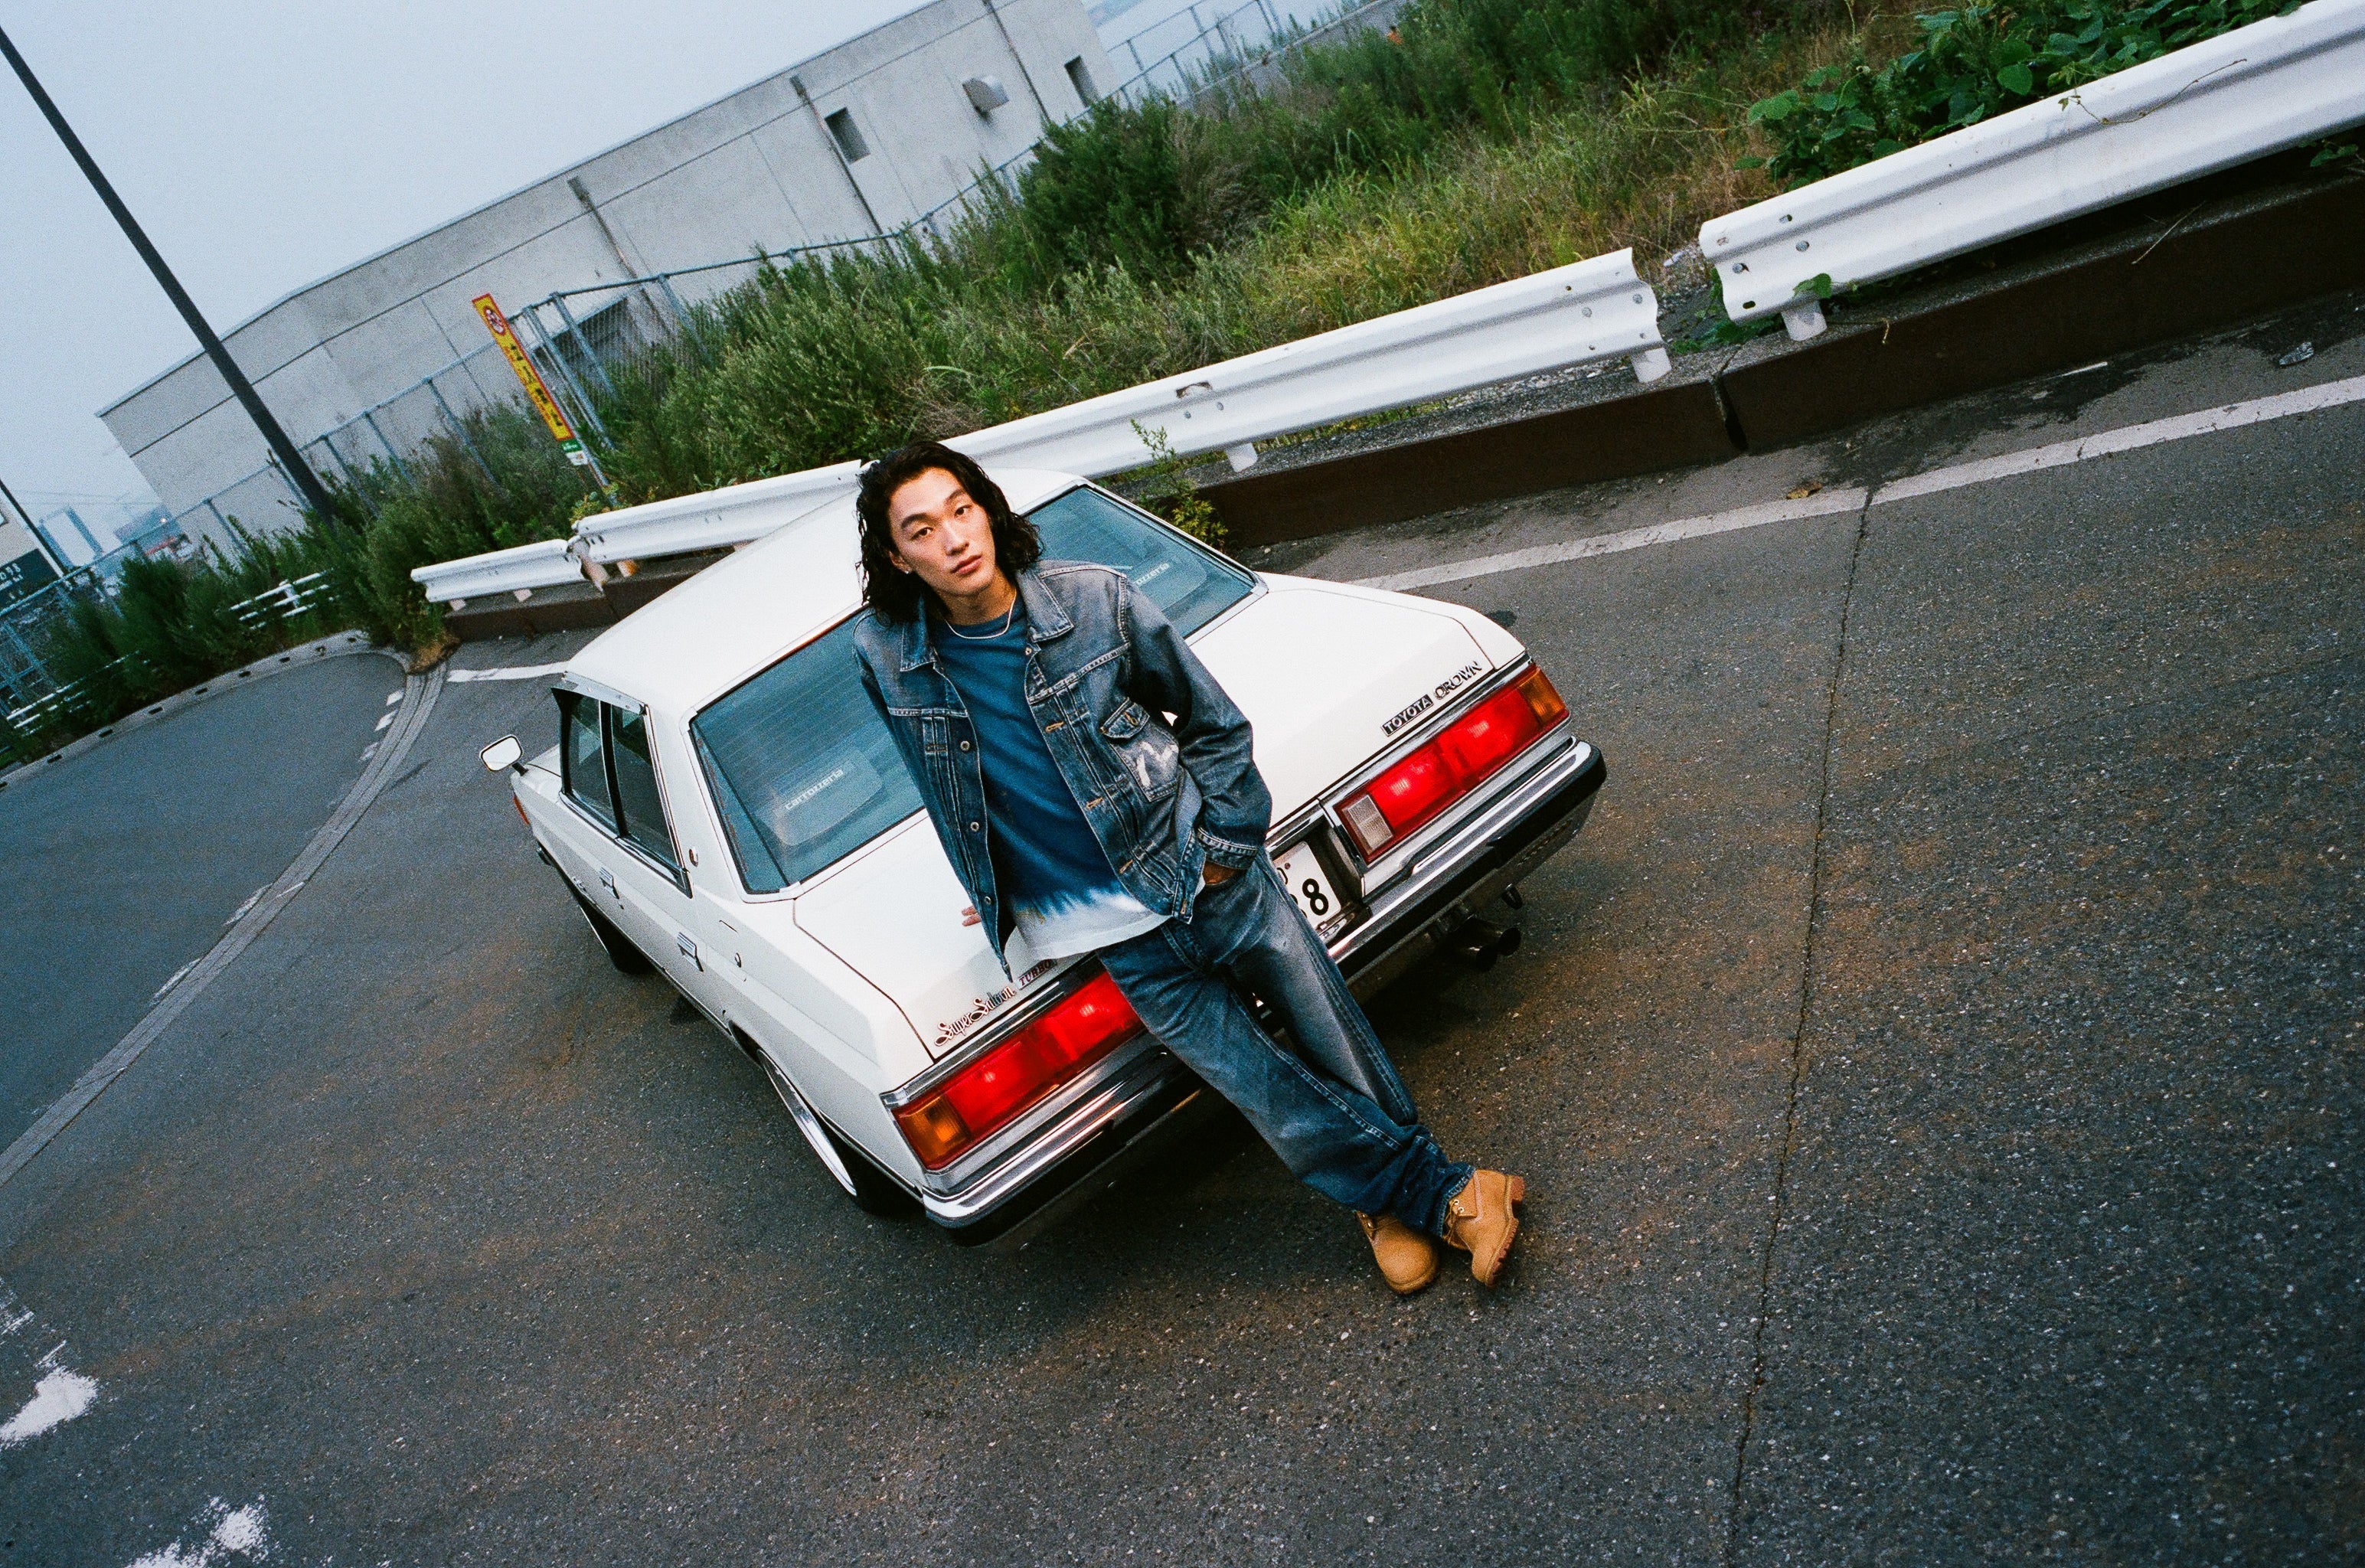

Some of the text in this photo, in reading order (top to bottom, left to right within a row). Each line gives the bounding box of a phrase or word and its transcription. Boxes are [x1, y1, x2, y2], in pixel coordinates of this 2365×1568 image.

[1134, 563, 1169, 586] ozzeria
[1383, 661, 1481, 734] TOYOTA CROWN
[785, 768, 844, 810] carrozzeria
[1289, 878, 1329, 918] 8
[934, 960, 1052, 1047] Super Saloon TURBO
